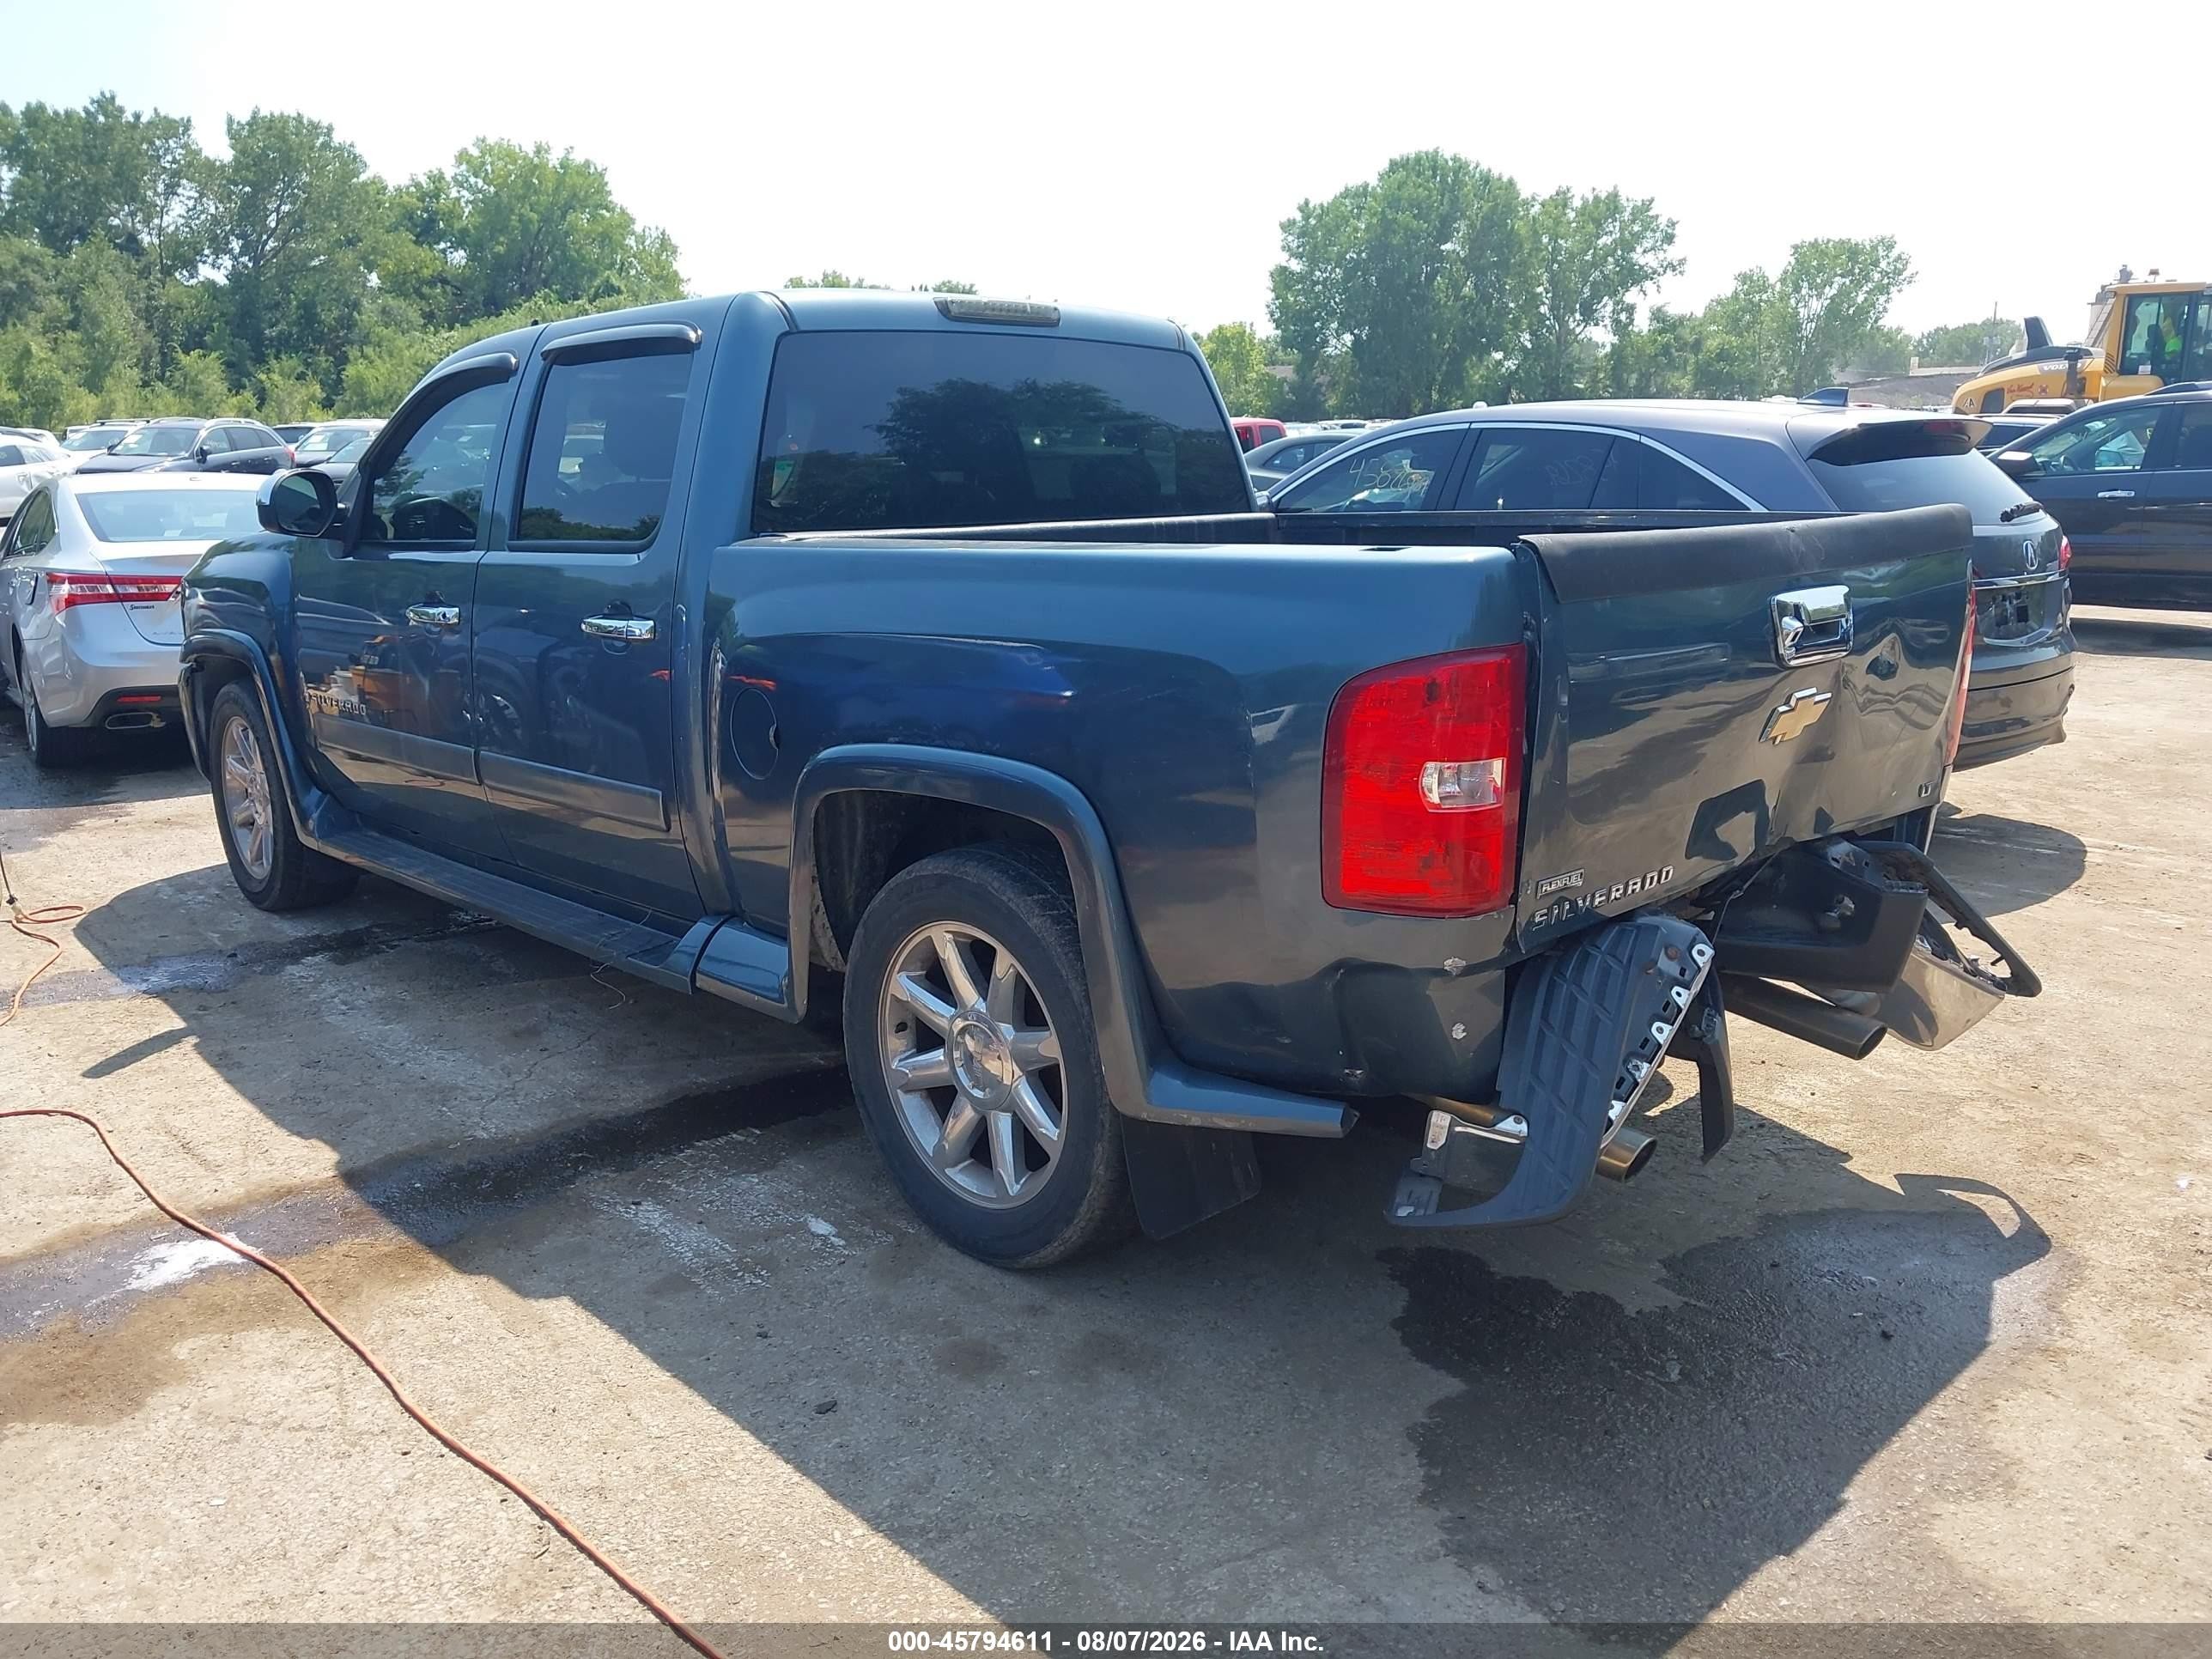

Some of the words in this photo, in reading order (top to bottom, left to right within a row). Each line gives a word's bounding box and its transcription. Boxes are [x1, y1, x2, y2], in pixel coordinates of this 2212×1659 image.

[310, 692, 367, 715] SILVERADO
[1542, 872, 1583, 892] FLEXFUEL
[1532, 865, 1674, 932] SILVERADO
